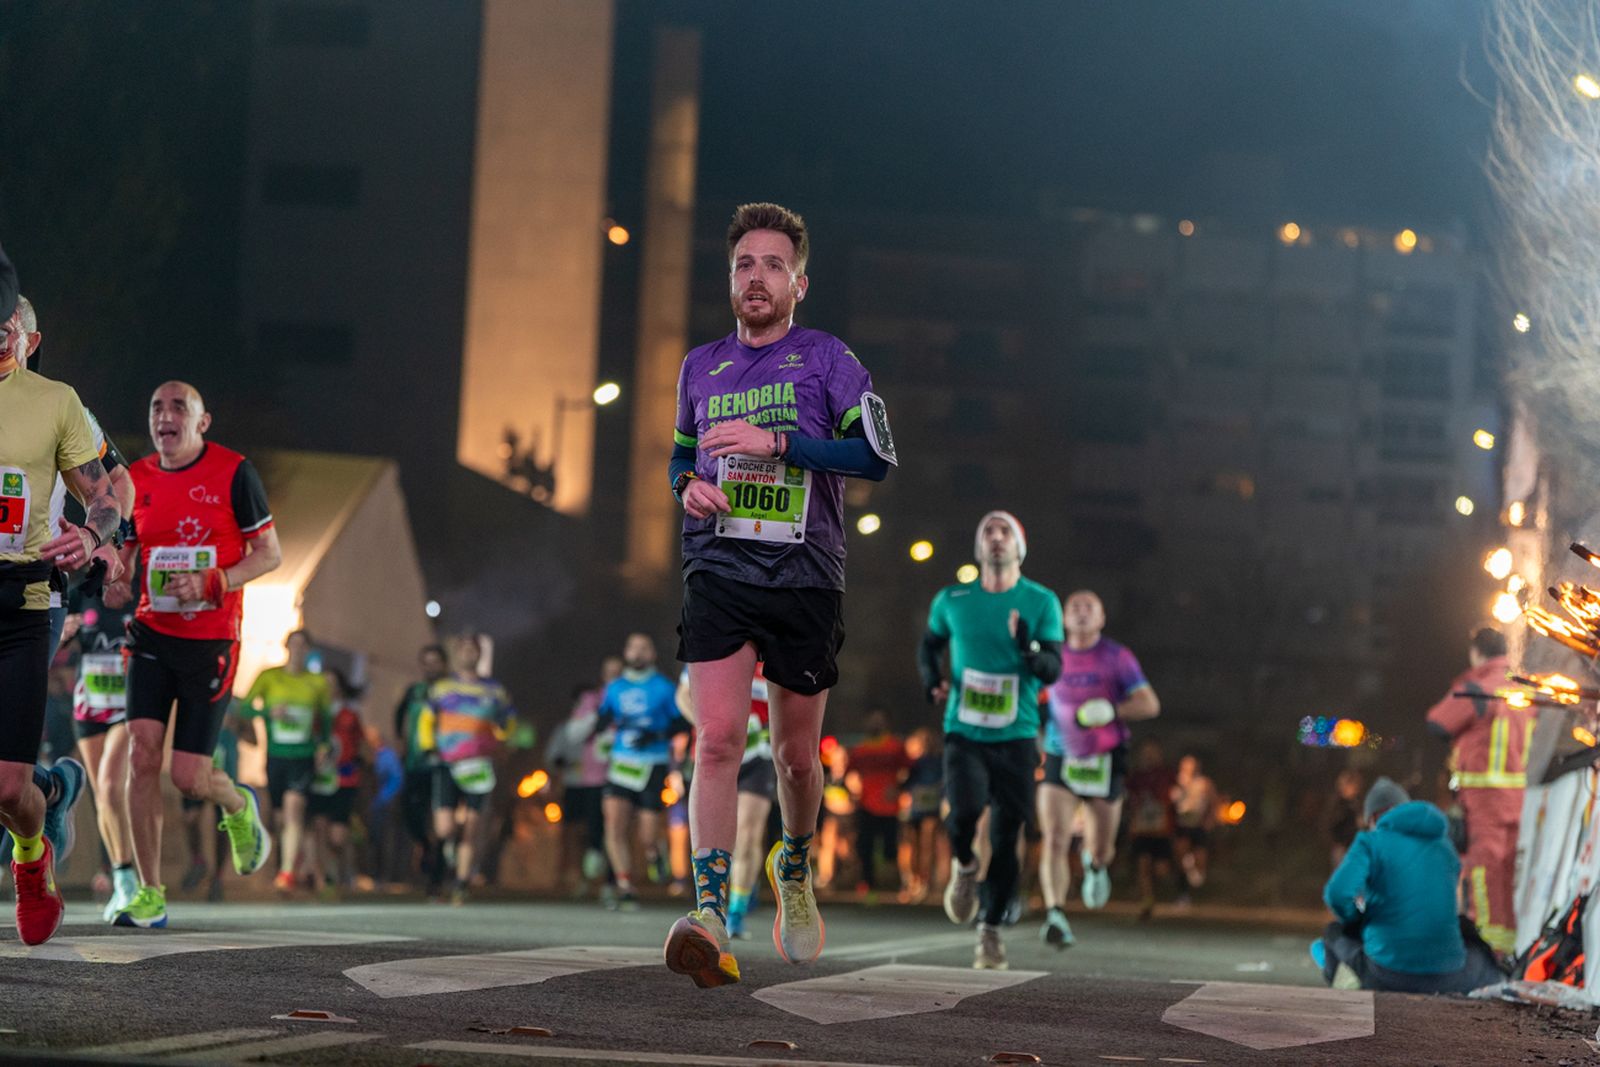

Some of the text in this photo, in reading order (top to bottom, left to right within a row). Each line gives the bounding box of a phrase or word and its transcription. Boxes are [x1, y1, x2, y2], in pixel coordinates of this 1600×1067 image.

[708, 382, 796, 419] BEHOBIA
[743, 404, 798, 425] BASTIÁN
[727, 471, 743, 481] SAN
[744, 471, 777, 484] ANTÓN
[737, 462, 764, 472] NOCHE
[765, 463, 777, 473] DE
[733, 484, 790, 513] 1060
